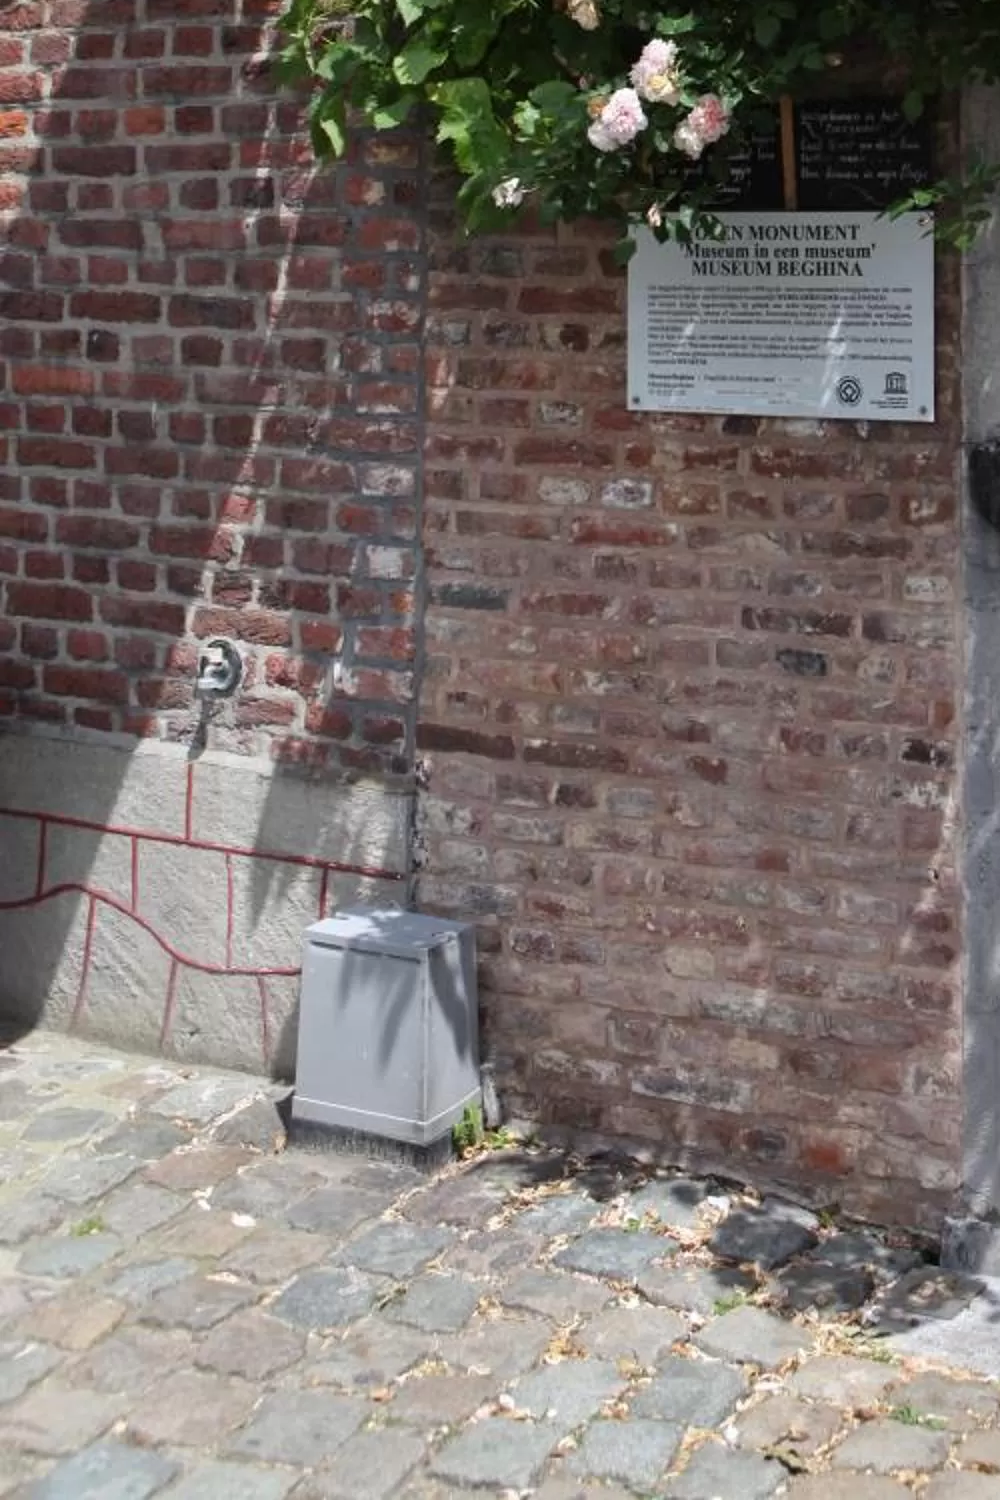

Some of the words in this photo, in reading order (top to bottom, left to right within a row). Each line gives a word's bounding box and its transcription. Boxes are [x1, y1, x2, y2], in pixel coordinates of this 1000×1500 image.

[695, 225, 743, 241] ON
[749, 225, 860, 241] MONUMENT
[754, 242, 770, 258] in
[773, 247, 799, 258] een
[692, 260, 771, 276] MUSEUM
[777, 260, 863, 276] BEGHINA
